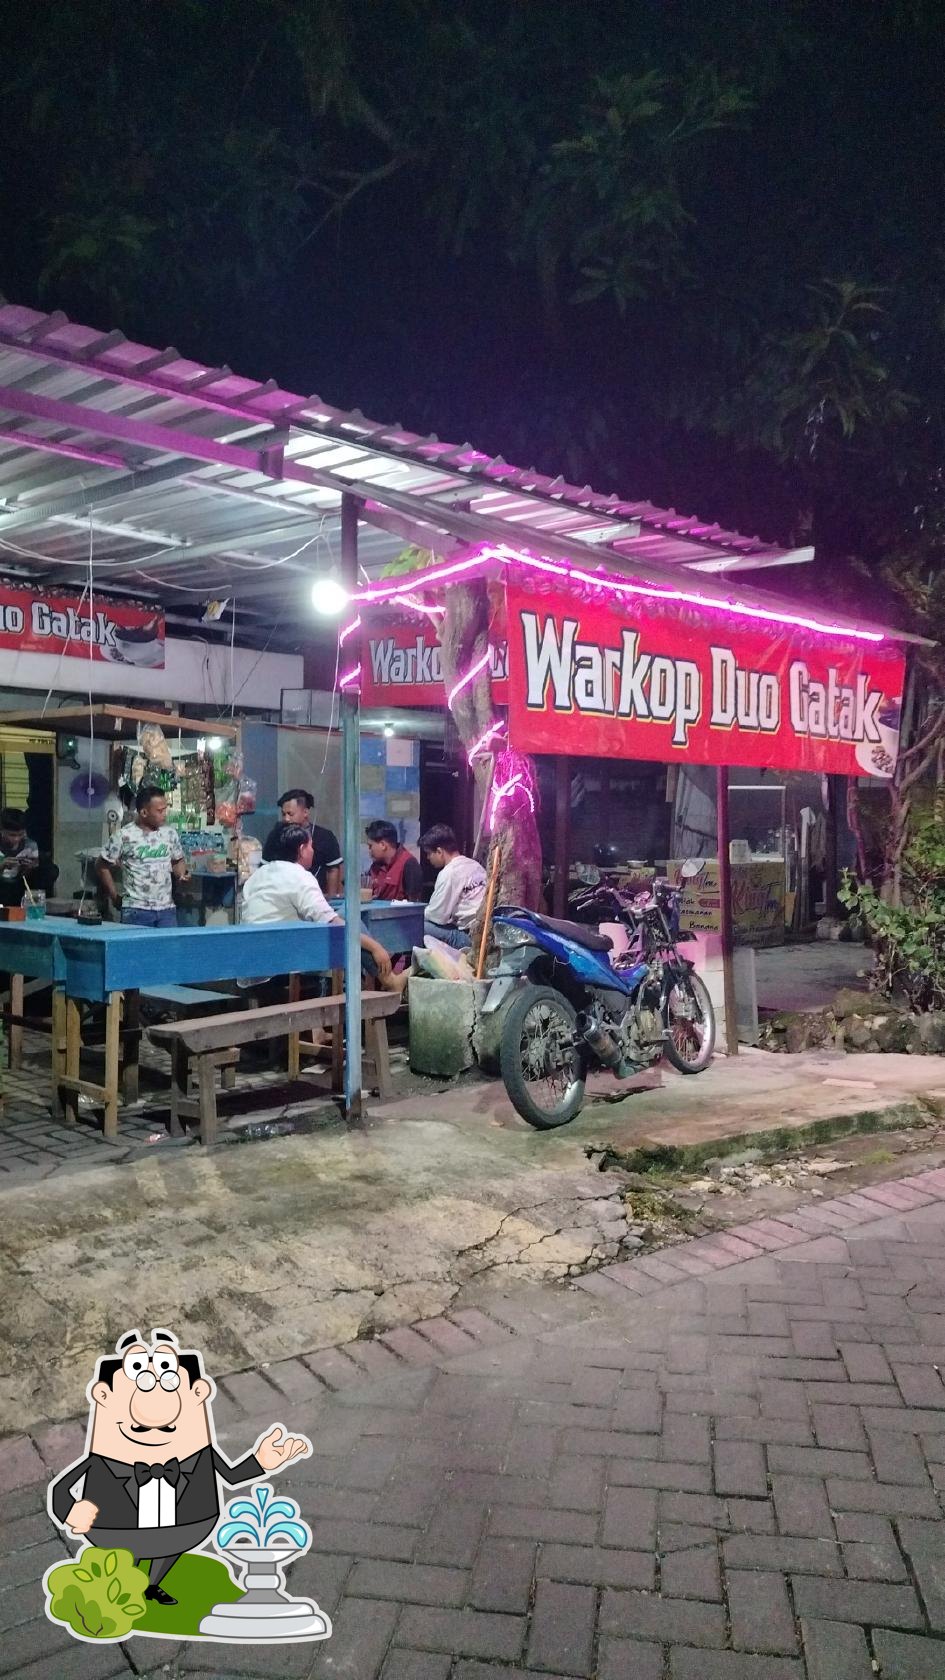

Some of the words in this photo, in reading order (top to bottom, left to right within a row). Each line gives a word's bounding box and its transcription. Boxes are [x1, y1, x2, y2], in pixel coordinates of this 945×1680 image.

[368, 635, 445, 686] Warko
[519, 611, 703, 749] Warkop
[709, 645, 781, 733] Duo
